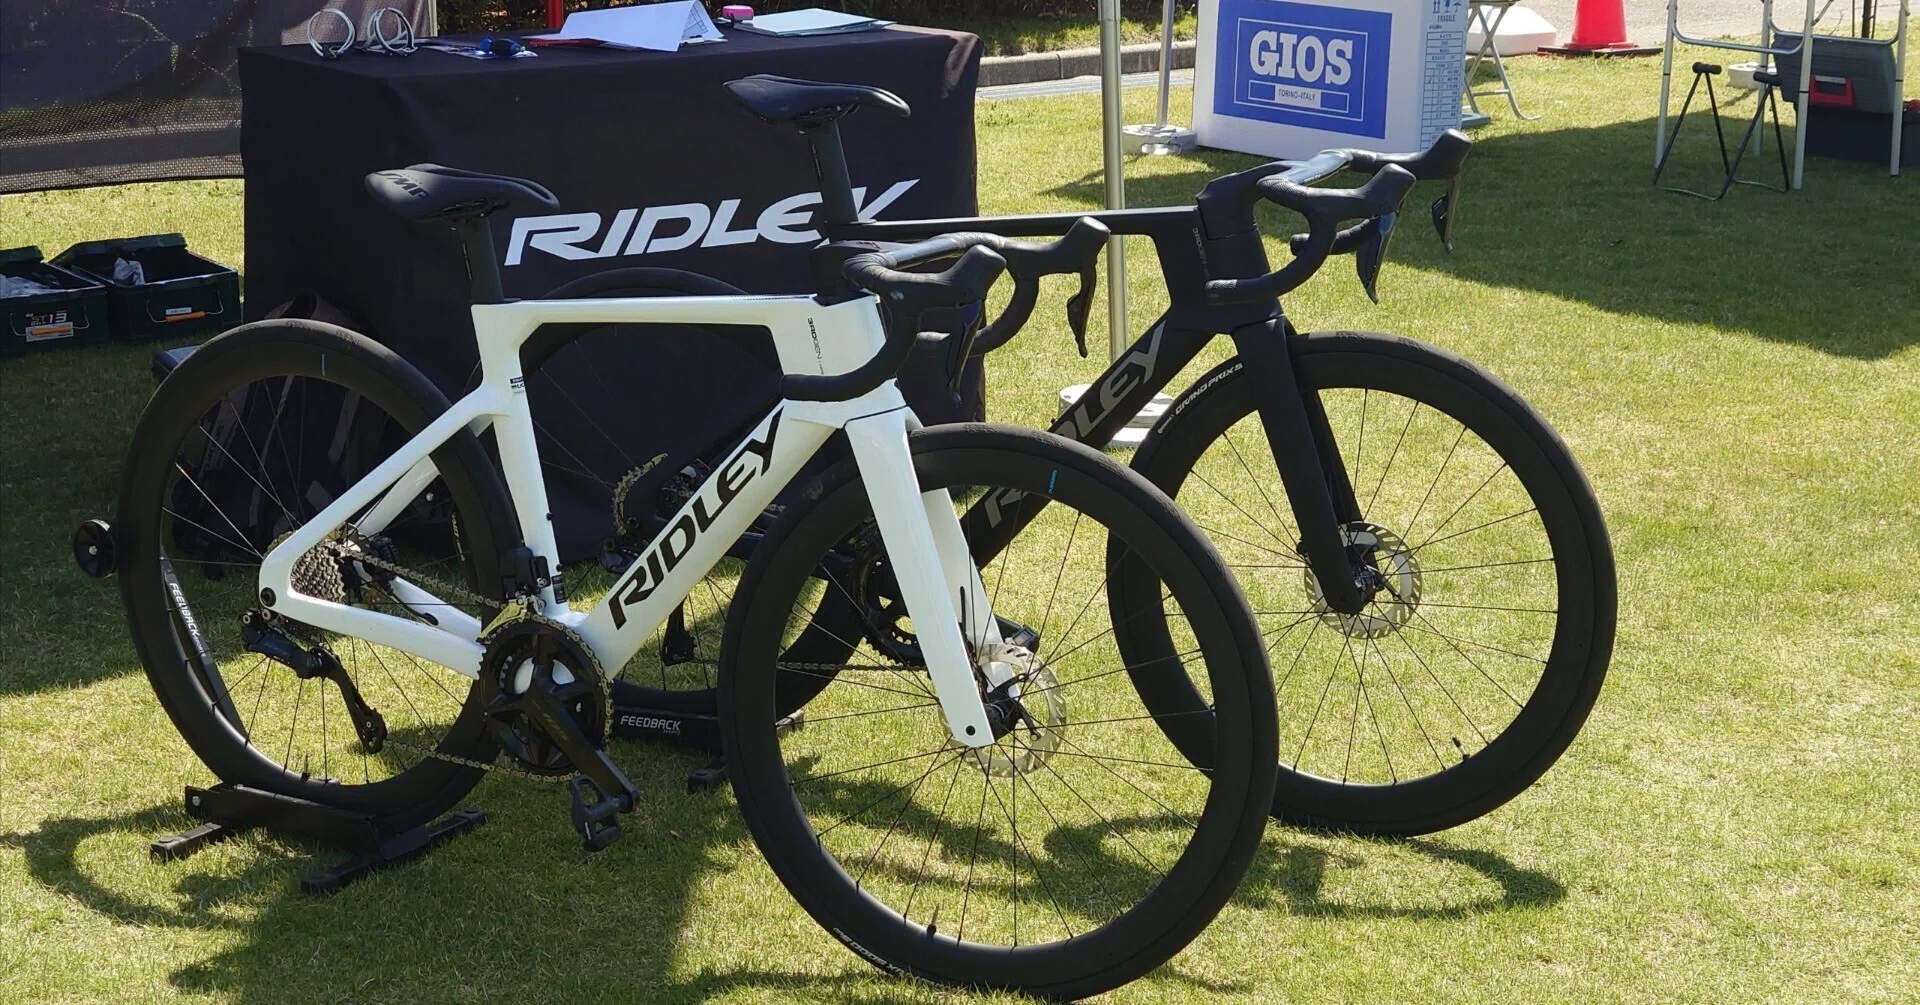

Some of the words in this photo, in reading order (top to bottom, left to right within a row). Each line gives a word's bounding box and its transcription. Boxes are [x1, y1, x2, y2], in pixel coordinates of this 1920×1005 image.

[1250, 30, 1353, 86] GIOS
[984, 320, 1166, 528] RLEY
[608, 405, 785, 631] RIDLEY
[169, 582, 200, 637] FEEDBACK
[620, 715, 681, 731] FEEDBACK
